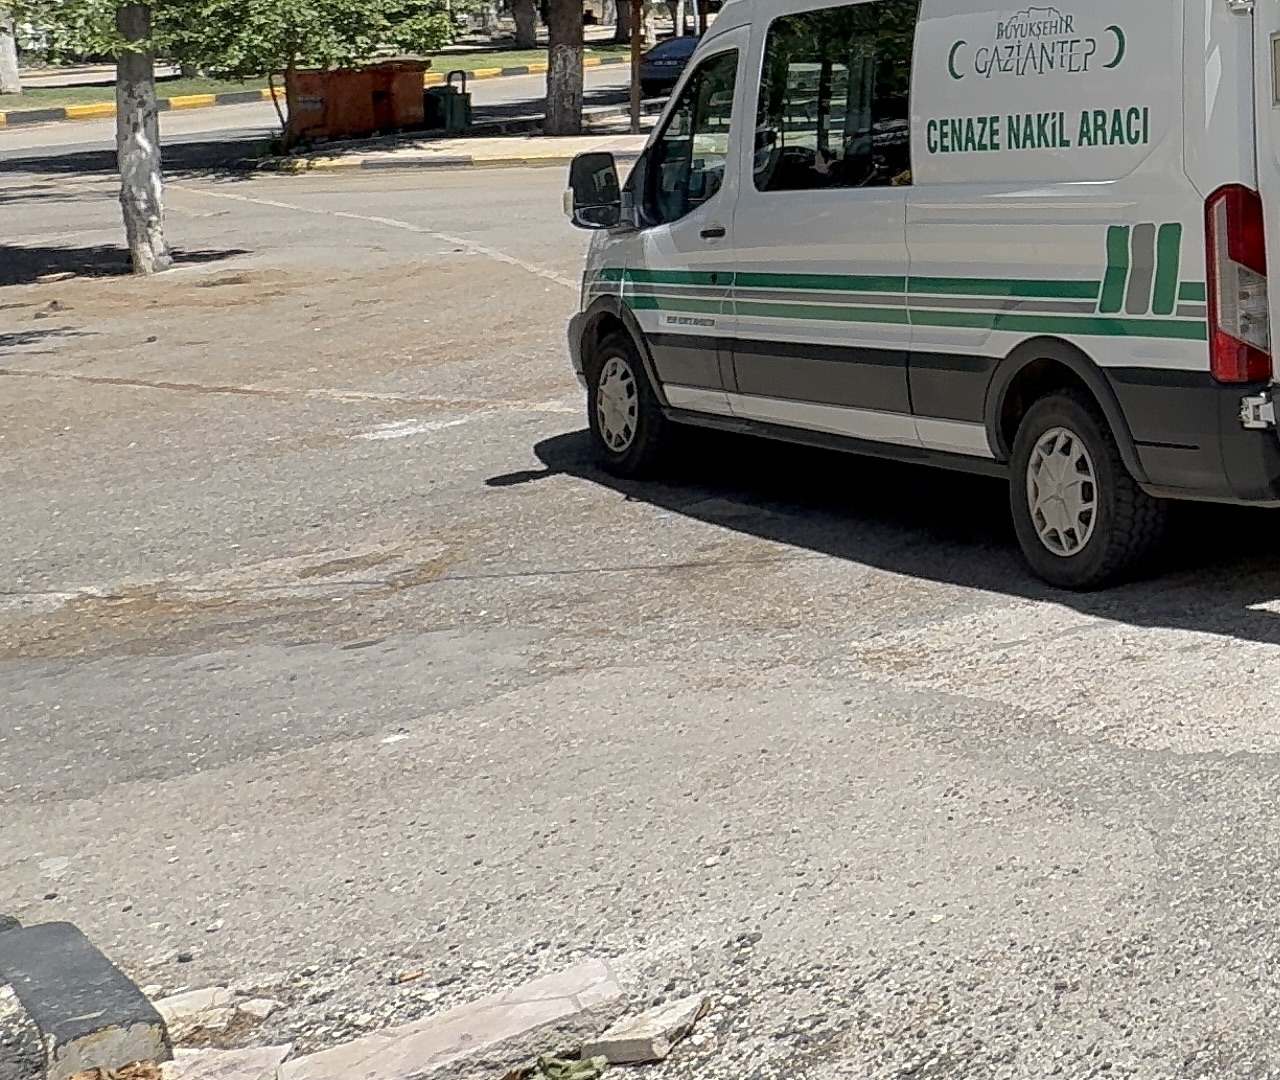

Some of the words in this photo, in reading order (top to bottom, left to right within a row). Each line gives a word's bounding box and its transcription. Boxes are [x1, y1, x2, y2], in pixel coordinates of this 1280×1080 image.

[975, 39, 1096, 78] GAZİANTEP
[927, 116, 1000, 153] CENAZE
[1007, 112, 1070, 149] NAKİL
[1078, 107, 1149, 146] ARACI
